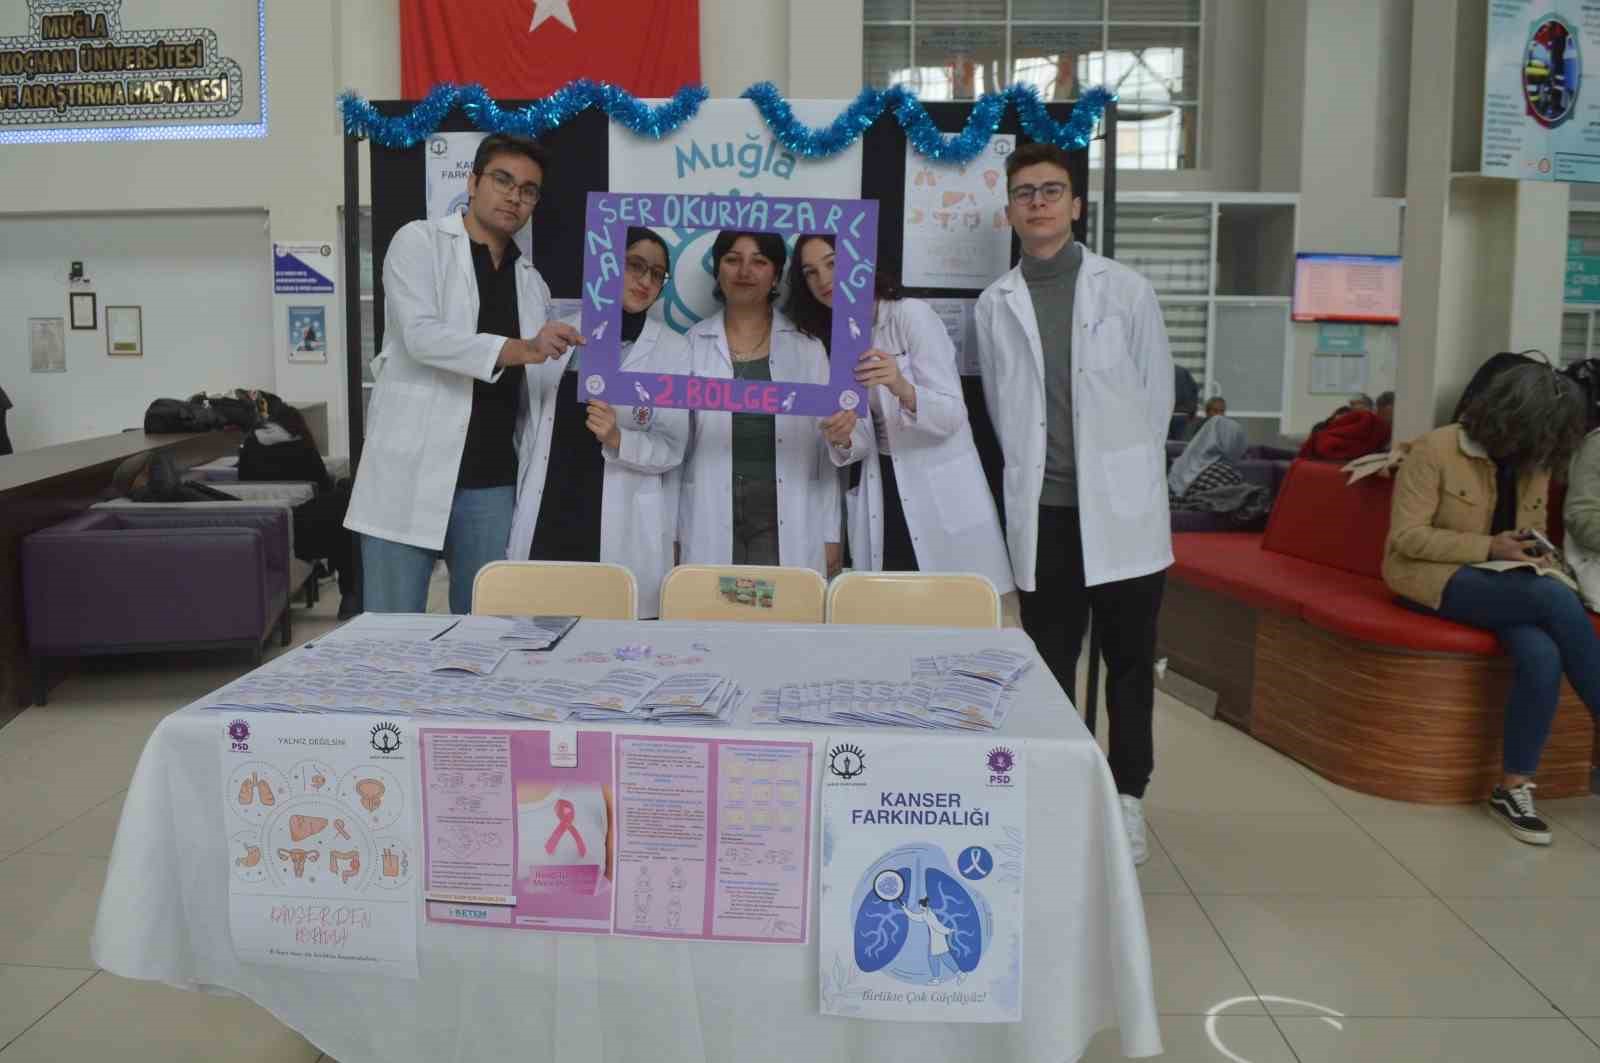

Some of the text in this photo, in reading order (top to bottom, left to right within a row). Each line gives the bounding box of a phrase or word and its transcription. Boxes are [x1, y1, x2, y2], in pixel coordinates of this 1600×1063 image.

[42, 10, 107, 39] MUĞLA
[0, 40, 204, 80] KOÇMAN ÜNİVERSİTESİ
[21, 81, 126, 112] ARAŞTIRMA
[674, 134, 797, 179] Muğla
[231, 742, 249, 751] PSD
[989, 775, 1010, 785] PSD
[880, 791, 961, 809] KANSER
[851, 808, 990, 827] FARKINDALIĞI
